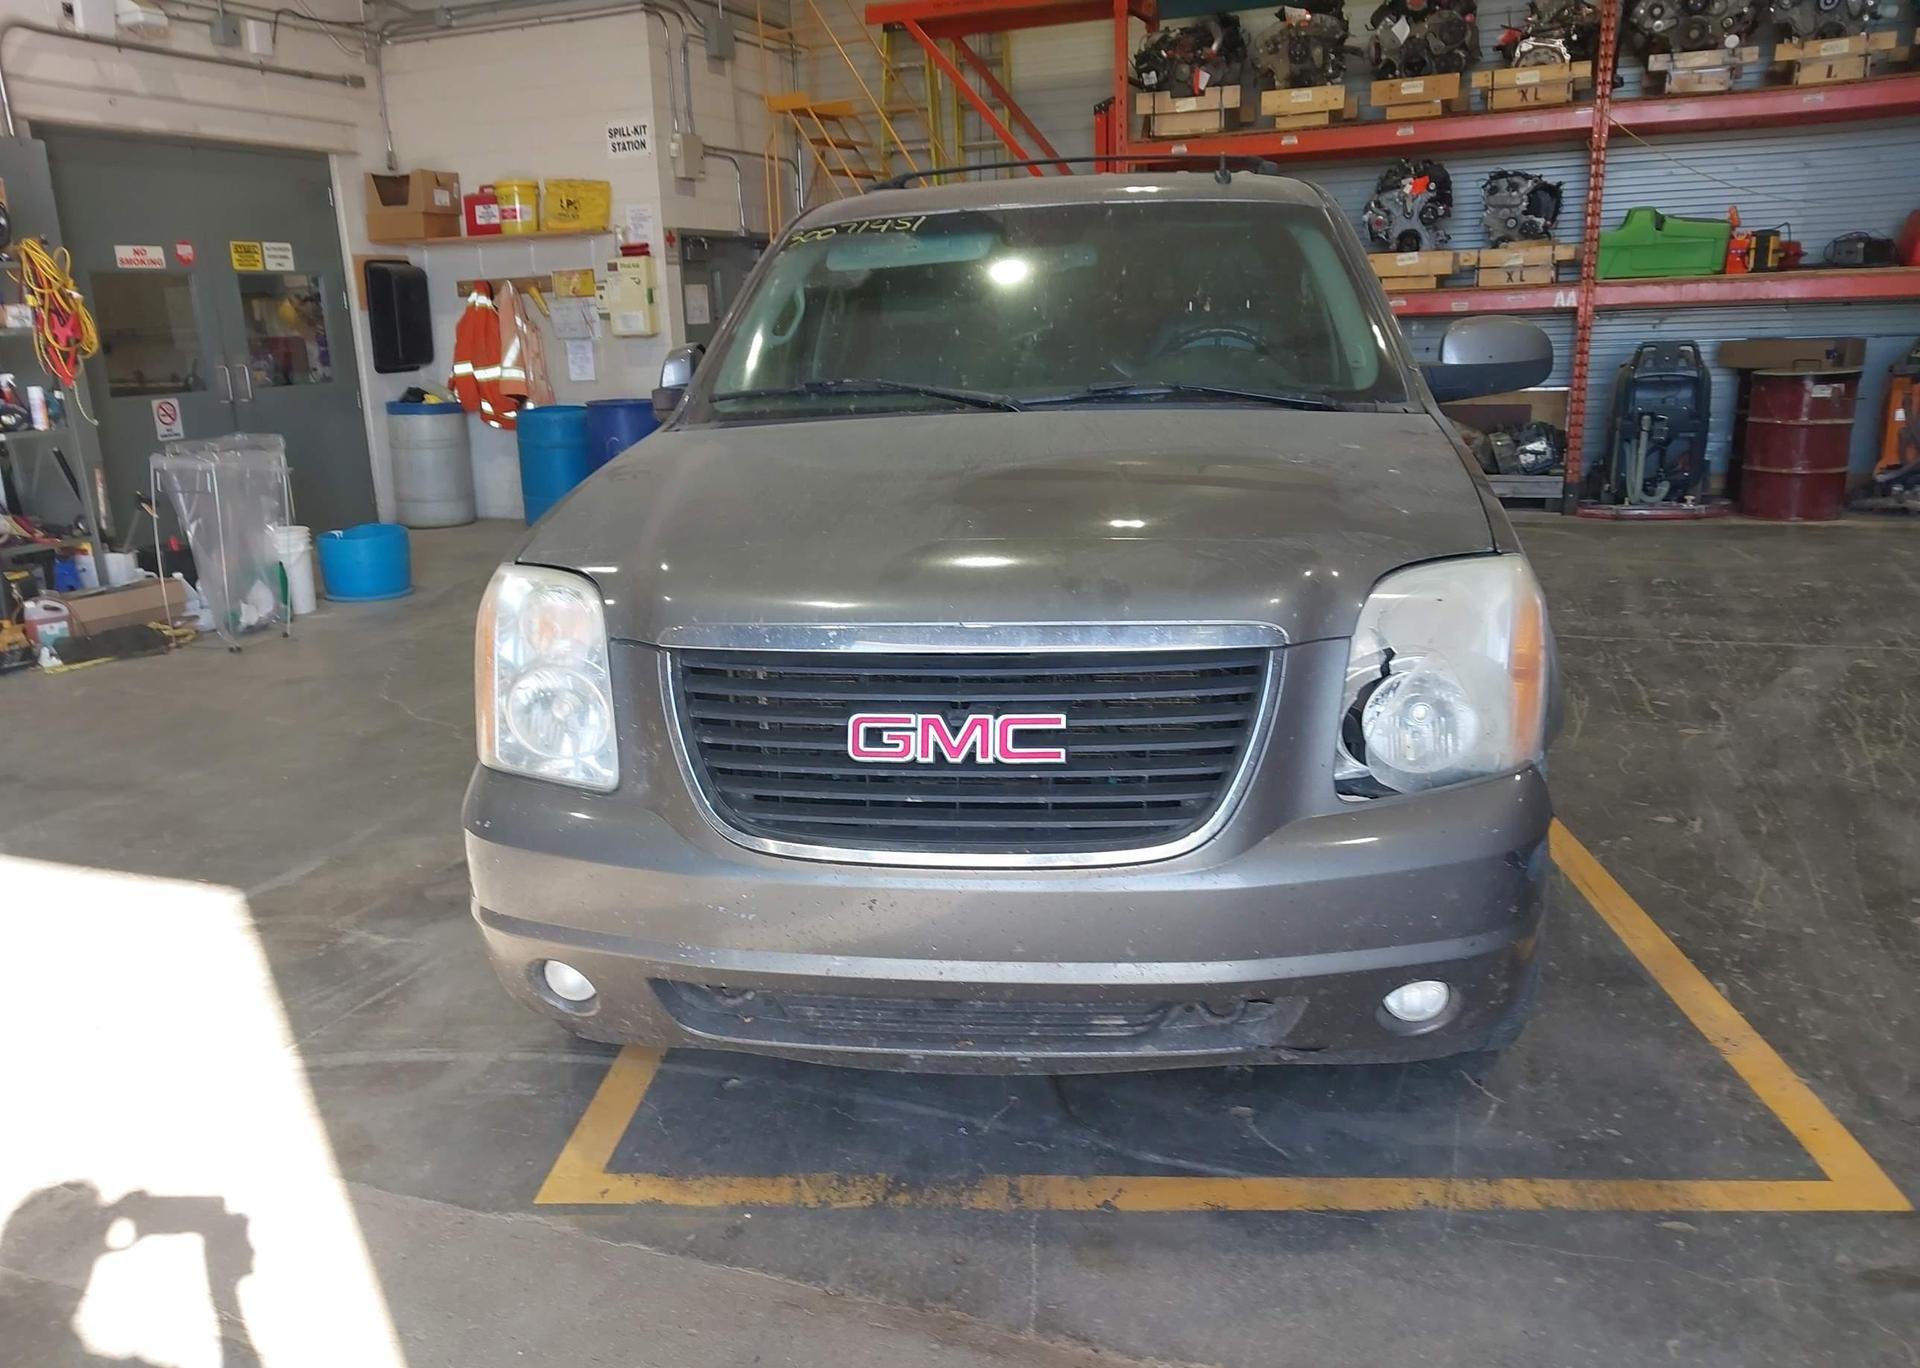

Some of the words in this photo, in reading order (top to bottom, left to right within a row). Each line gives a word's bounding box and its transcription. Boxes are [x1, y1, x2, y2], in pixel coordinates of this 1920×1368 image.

[607, 124, 648, 139] SPILL-KIT
[610, 139, 647, 153] STATION
[132, 247, 148, 257] NO
[119, 256, 163, 267] SMOKING
[848, 713, 1067, 763] GMC
